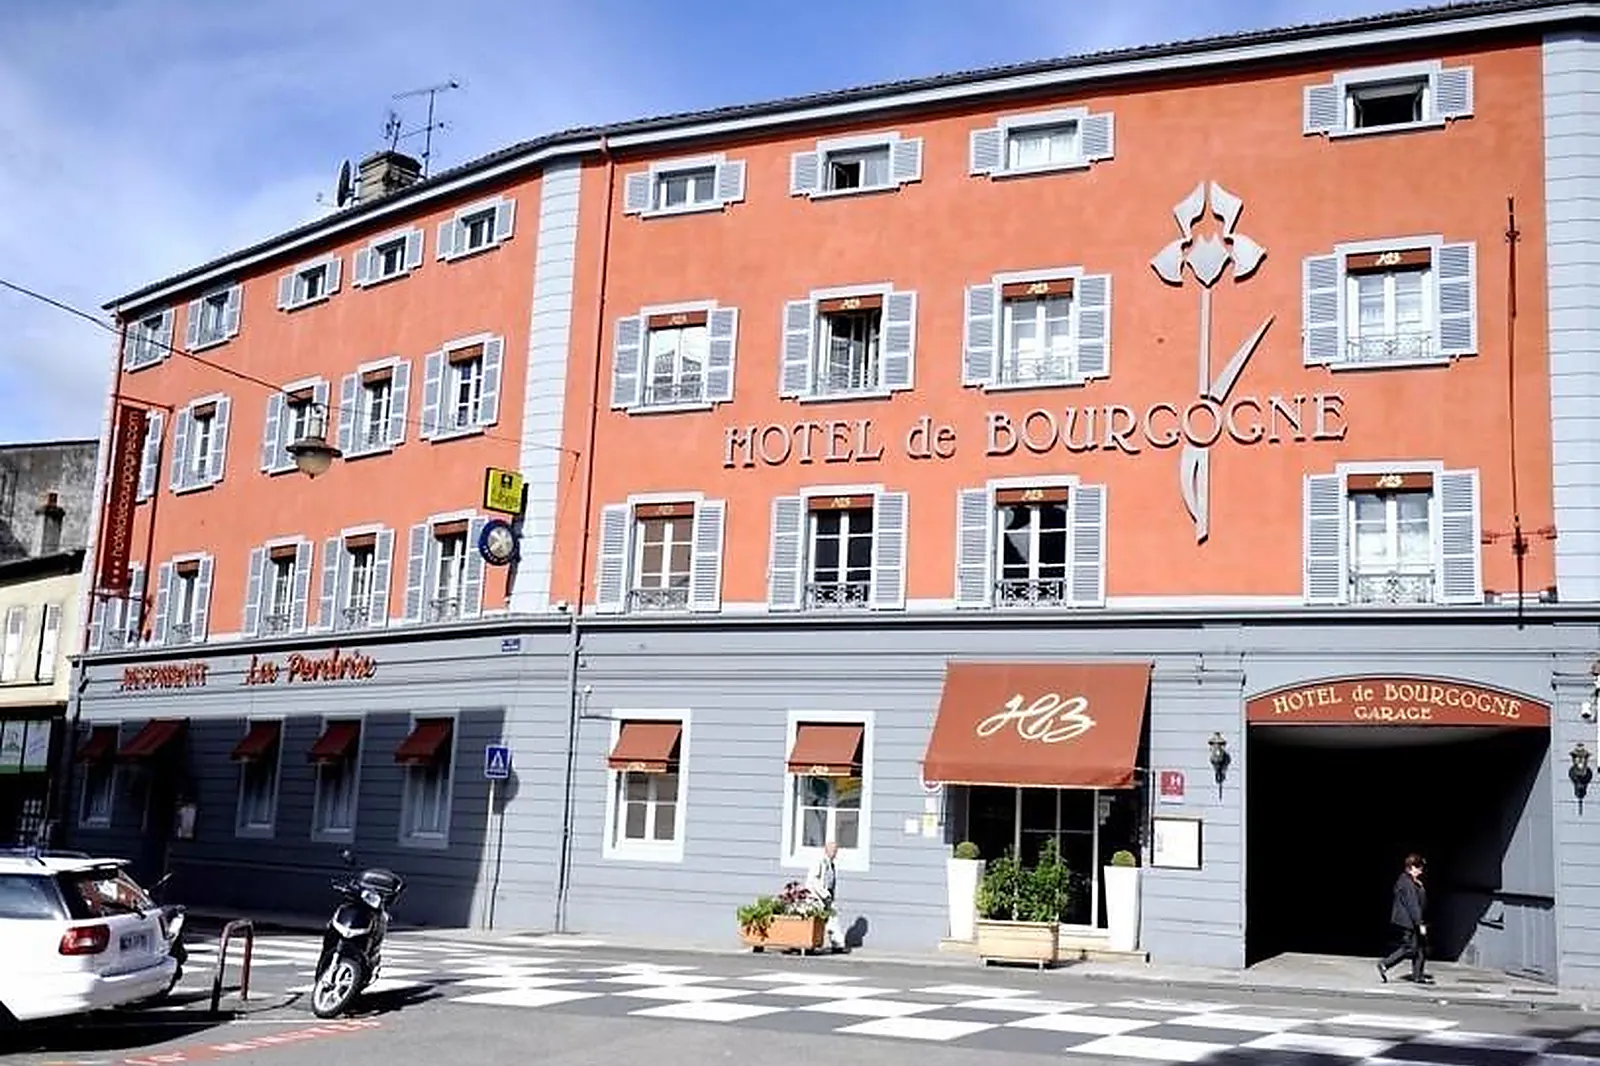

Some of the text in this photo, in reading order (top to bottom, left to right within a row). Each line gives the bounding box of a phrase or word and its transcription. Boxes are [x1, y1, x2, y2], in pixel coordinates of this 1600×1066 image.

[724, 395, 1349, 469] HOTEL de BOURGOGNE
[1272, 683, 1522, 719] HOTEL de BOURGOGNE
[1354, 706, 1432, 721] GARAGE
